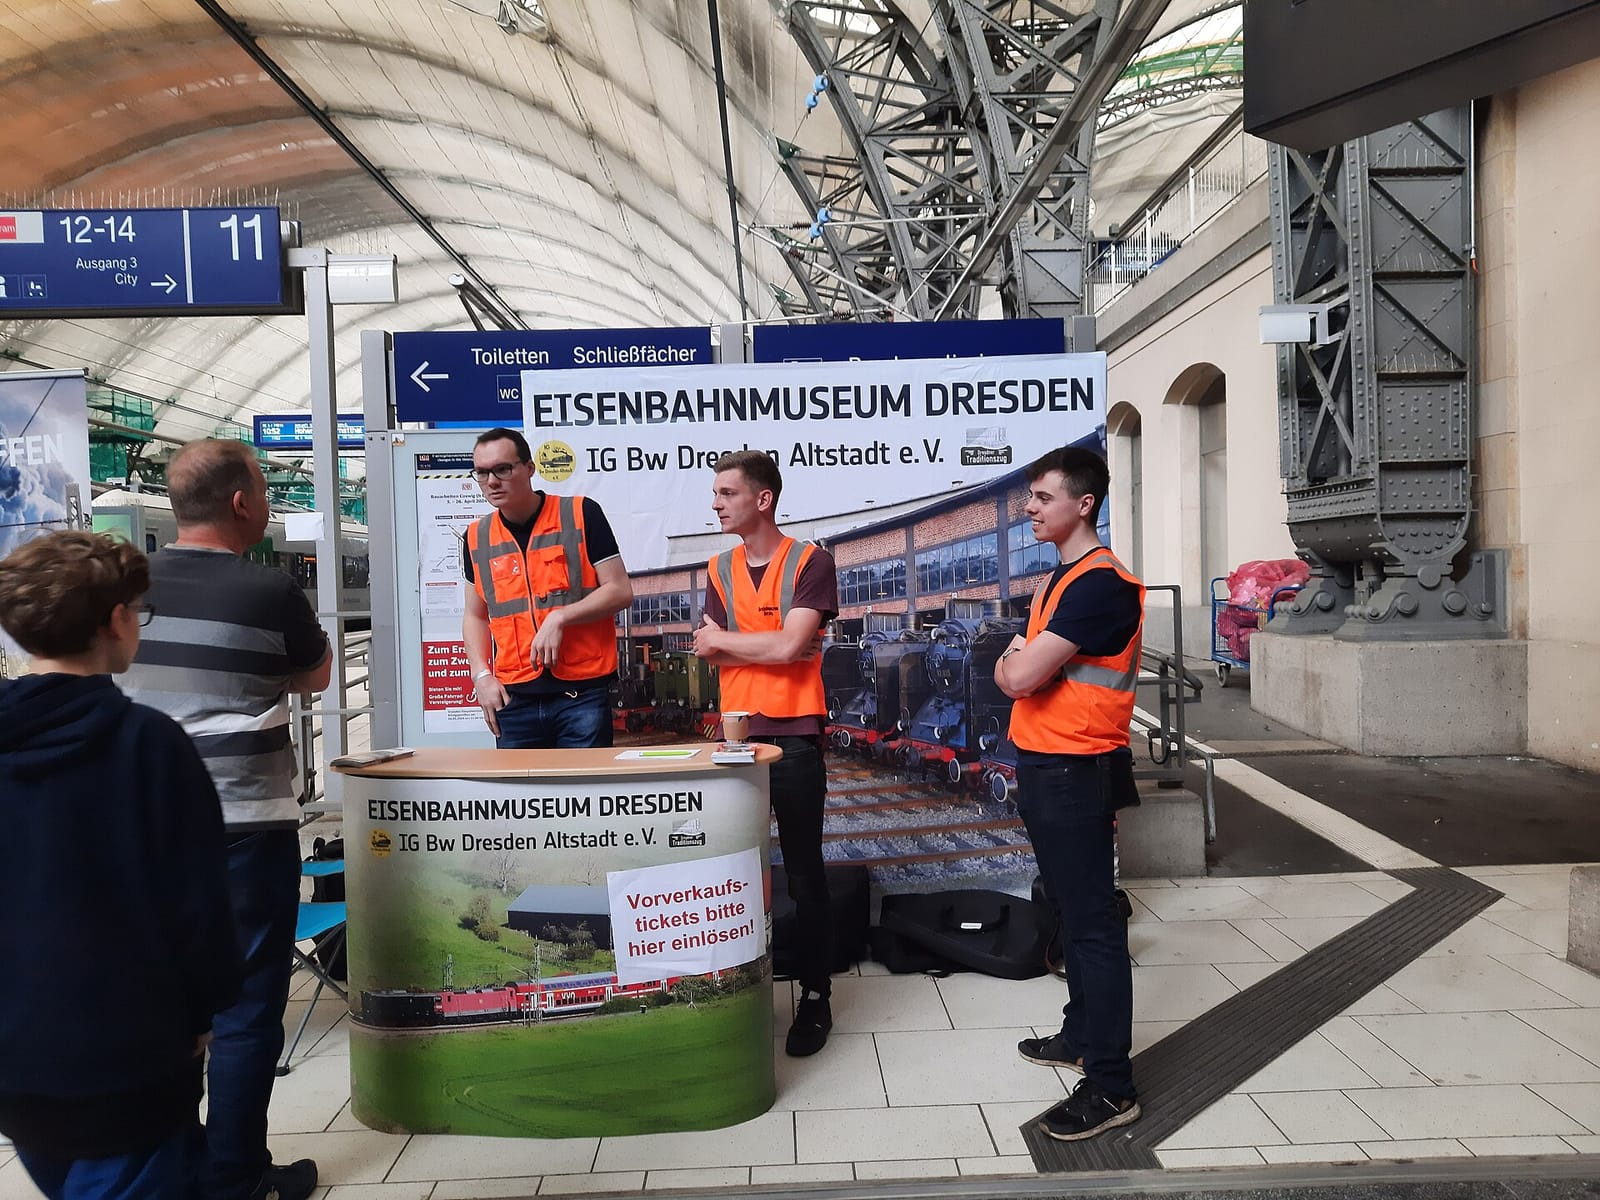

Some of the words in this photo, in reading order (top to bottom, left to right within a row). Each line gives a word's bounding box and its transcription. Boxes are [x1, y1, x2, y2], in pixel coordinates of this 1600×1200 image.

[59, 215, 136, 243] 12-14
[219, 213, 263, 261] 11
[75, 257, 127, 270] Ausgang
[129, 257, 138, 269] 3
[114, 272, 138, 287] City
[471, 347, 549, 365] Toiletten
[573, 345, 697, 364] Schließfächer
[500, 388, 519, 400] WC
[533, 383, 911, 428] EISENBAHNMUSEUM
[925, 377, 1094, 417] DRESDEN
[586, 447, 617, 473] IG
[627, 446, 668, 472] Bw
[789, 440, 891, 467] Altstadt
[966, 454, 1008, 464] Traditionszug
[428, 646, 450, 654] Zum
[428, 658, 449, 666] zum
[428, 669, 447, 677] und
[367, 797, 591, 822] EISENBAHNMUSEUM
[599, 791, 703, 817] DRESDEN
[399, 833, 420, 852] IG
[426, 833, 456, 852] Bw
[462, 832, 537, 851] Dresden
[543, 829, 618, 850] Altstadt
[627, 879, 749, 910] Vorverkaufs-
[635, 911, 700, 933] tickets
[705, 902, 746, 922] bitte
[628, 940, 666, 958] hier
[671, 919, 755, 950] einlösen!
